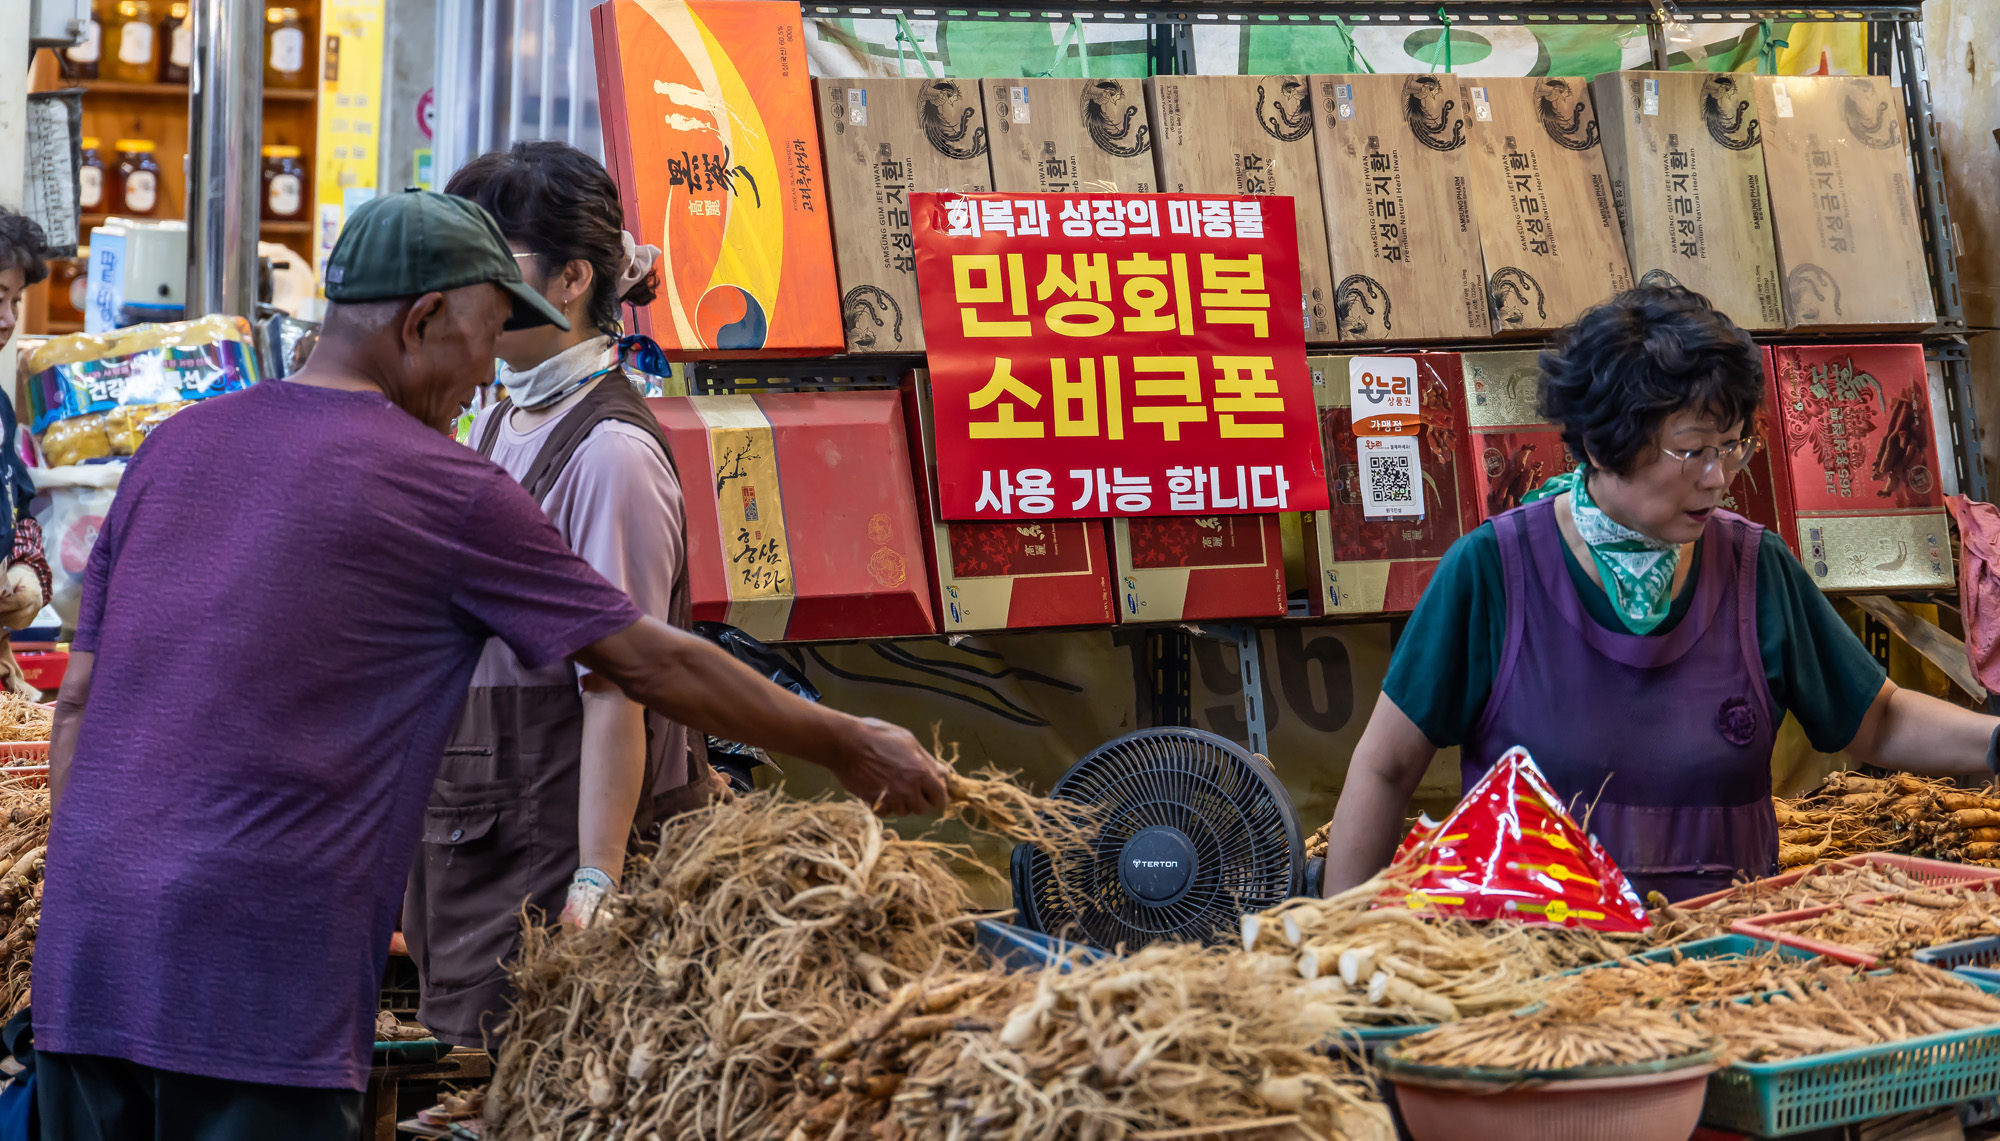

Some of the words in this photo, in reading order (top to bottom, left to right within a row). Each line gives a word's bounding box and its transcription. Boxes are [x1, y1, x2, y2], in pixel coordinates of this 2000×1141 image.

[777, 25, 785, 45] 60.5%
[904, 157, 915, 181] Hwan
[1037, 161, 1046, 185] HWAN
[1234, 153, 1243, 189] Premium
[1362, 155, 1370, 179] HWAN
[1501, 154, 1511, 178] HWAN
[1529, 149, 1538, 170] Hwan
[793, 139, 814, 212] 고려흑삼정과
[873, 163, 881, 187] HWAN
[1394, 173, 1402, 193] Herb
[1454, 176, 1462, 199] PHARM
[1534, 172, 1543, 190] Herb
[1592, 174, 1602, 196] PHARM
[1748, 174, 1756, 197] PHARM
[688, 199, 721, 216] 高麗
[875, 190, 883, 204] JEE
[1370, 151, 1401, 263] 삼성금지환
[1396, 195, 1406, 225] Natural
[1509, 151, 1549, 257] 삼성금지환
[1510, 194, 1519, 212] GUM
[1538, 192, 1550, 221] Natural
[1670, 149, 1697, 259] 삼성금지환
[1694, 193, 1702, 221] Natural
[877, 206, 885, 225] GUM
[880, 158, 914, 275] 삼성금지환
[944, 199, 1050, 238] 회복과
[1059, 199, 1160, 238] 성장의
[1167, 200, 1265, 239] 마중물
[1457, 200, 1467, 232] SAMSUNG
[1597, 197, 1609, 227] SAMSUNG
[1751, 198, 1761, 229] SAMSUNG
[1369, 218, 1379, 257] SAMSUNG
[1401, 227, 1410, 262] Premium
[1516, 214, 1528, 252] SAMSUNG
[1546, 222, 1558, 256] Premium
[1668, 215, 1677, 253] SAMSUNG
[1698, 224, 1706, 258] Premium
[880, 228, 891, 268] SAMSUNG
[951, 252, 1271, 338] 민생회복
[968, 355, 1285, 441] 소비쿠폰
[1387, 396, 1411, 406] 상품권
[1794, 401, 1804, 411] 6
[1370, 419, 1403, 432] 가맹점
[974, 468, 1055, 514] 사용
[1069, 467, 1152, 513] 가능
[1165, 464, 1290, 511] 합니다
[1823, 469, 1837, 496] 고려
[733, 527, 782, 564] 홍삼
[741, 566, 786, 593] 정과
[1142, 860, 1178, 868] TERTON
